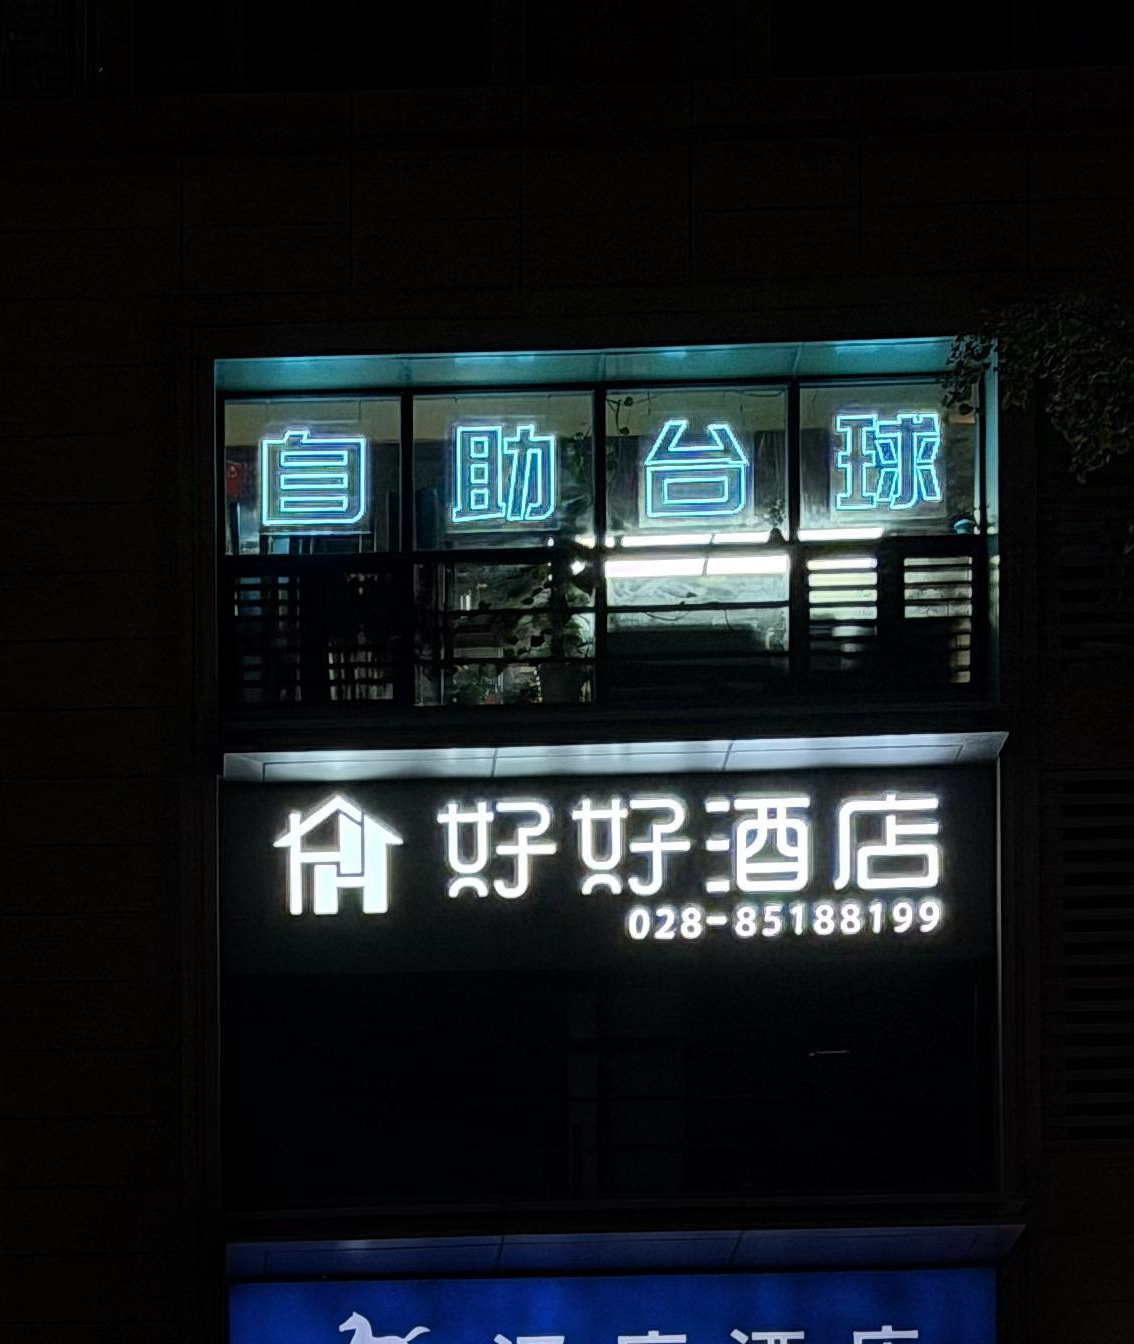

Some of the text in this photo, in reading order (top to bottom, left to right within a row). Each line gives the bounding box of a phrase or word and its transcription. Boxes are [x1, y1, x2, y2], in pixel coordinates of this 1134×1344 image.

[261, 411, 944, 526] 自助台球
[436, 793, 941, 899] 好好酒店
[628, 899, 943, 940] 028-85188199
